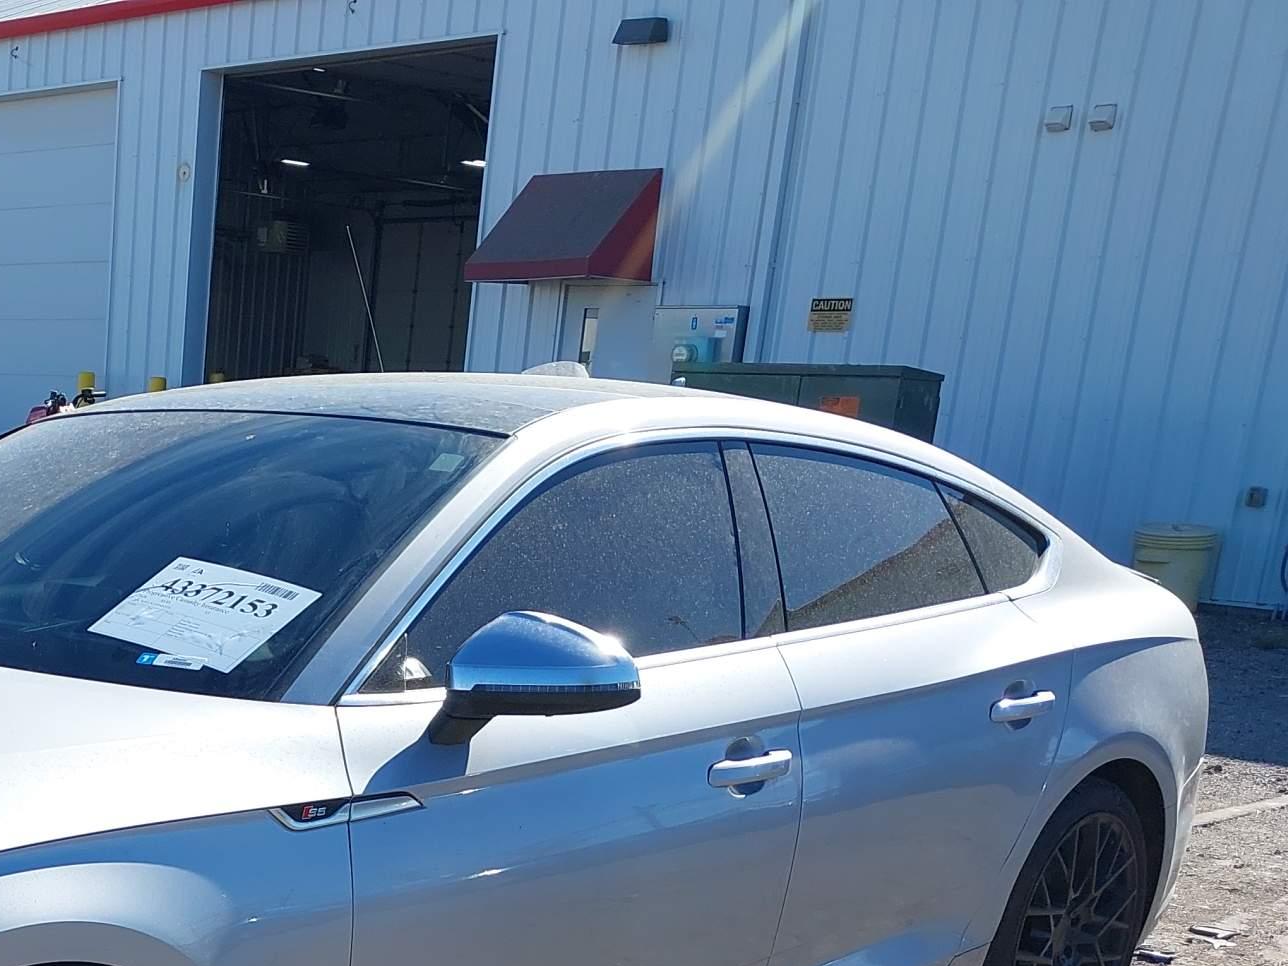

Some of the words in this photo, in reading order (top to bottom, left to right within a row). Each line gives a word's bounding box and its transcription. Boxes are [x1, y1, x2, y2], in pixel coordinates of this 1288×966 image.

[812, 300, 852, 310] CAUTION
[161, 578, 279, 618] 43372153
[307, 806, 328, 817] S5
